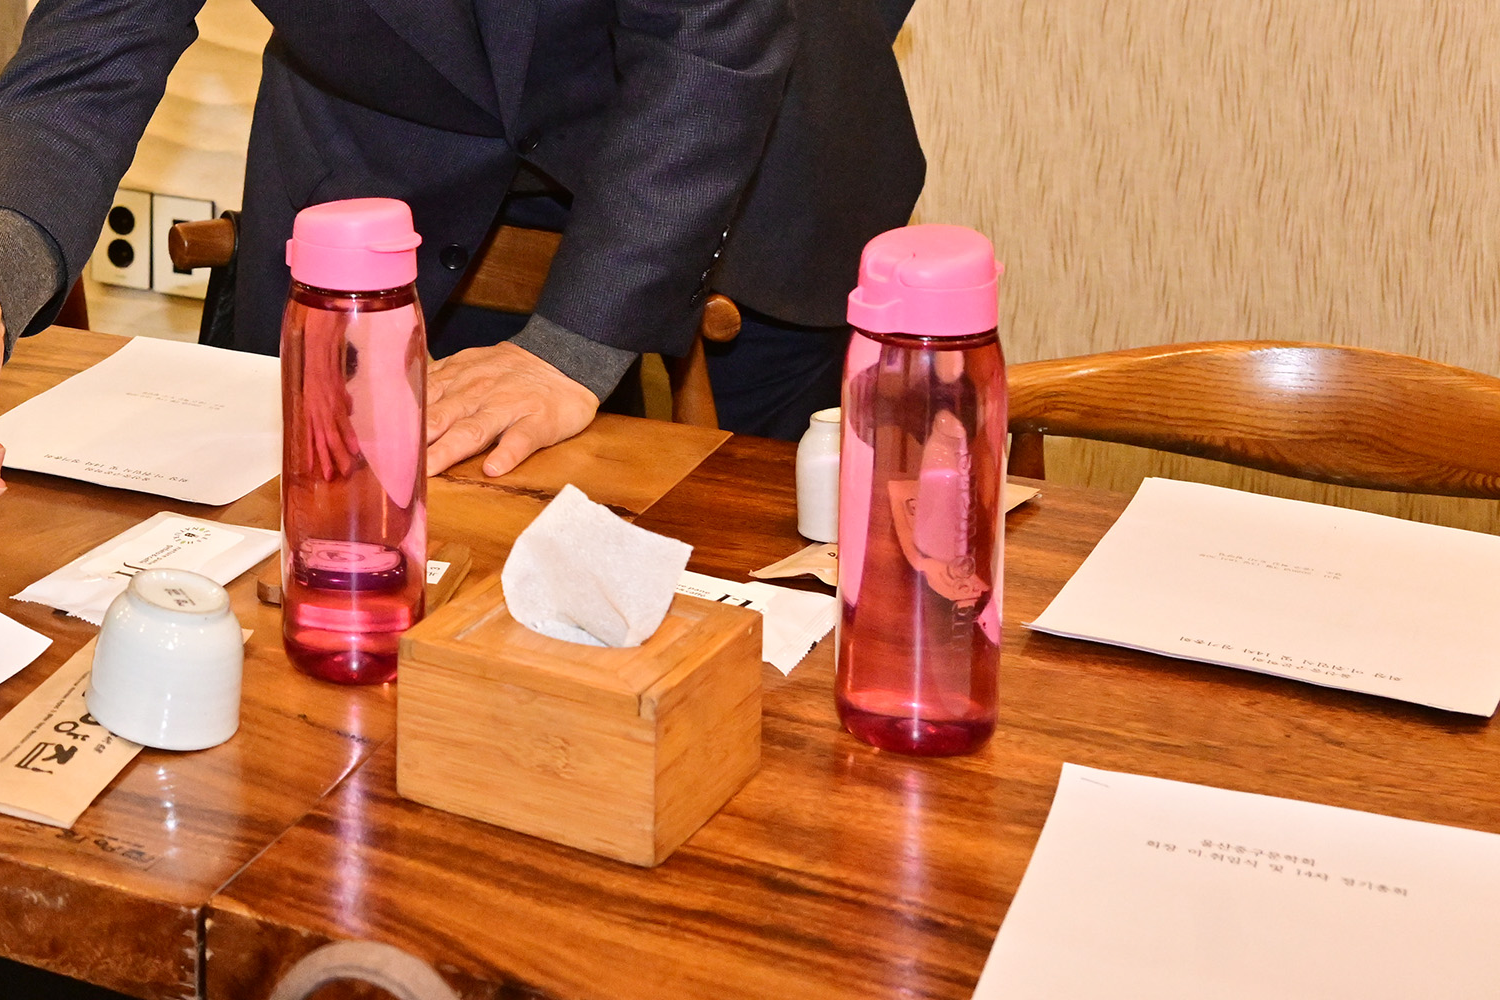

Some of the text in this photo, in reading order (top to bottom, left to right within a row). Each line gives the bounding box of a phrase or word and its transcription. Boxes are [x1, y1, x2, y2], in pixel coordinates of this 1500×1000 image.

[1147, 839, 1177, 853] 회장
[1268, 863, 1284, 874] 및
[1296, 867, 1329, 883] 14차
[1341, 876, 1408, 897] 정기총회
[1200, 839, 1316, 868] 울산중구문학회
